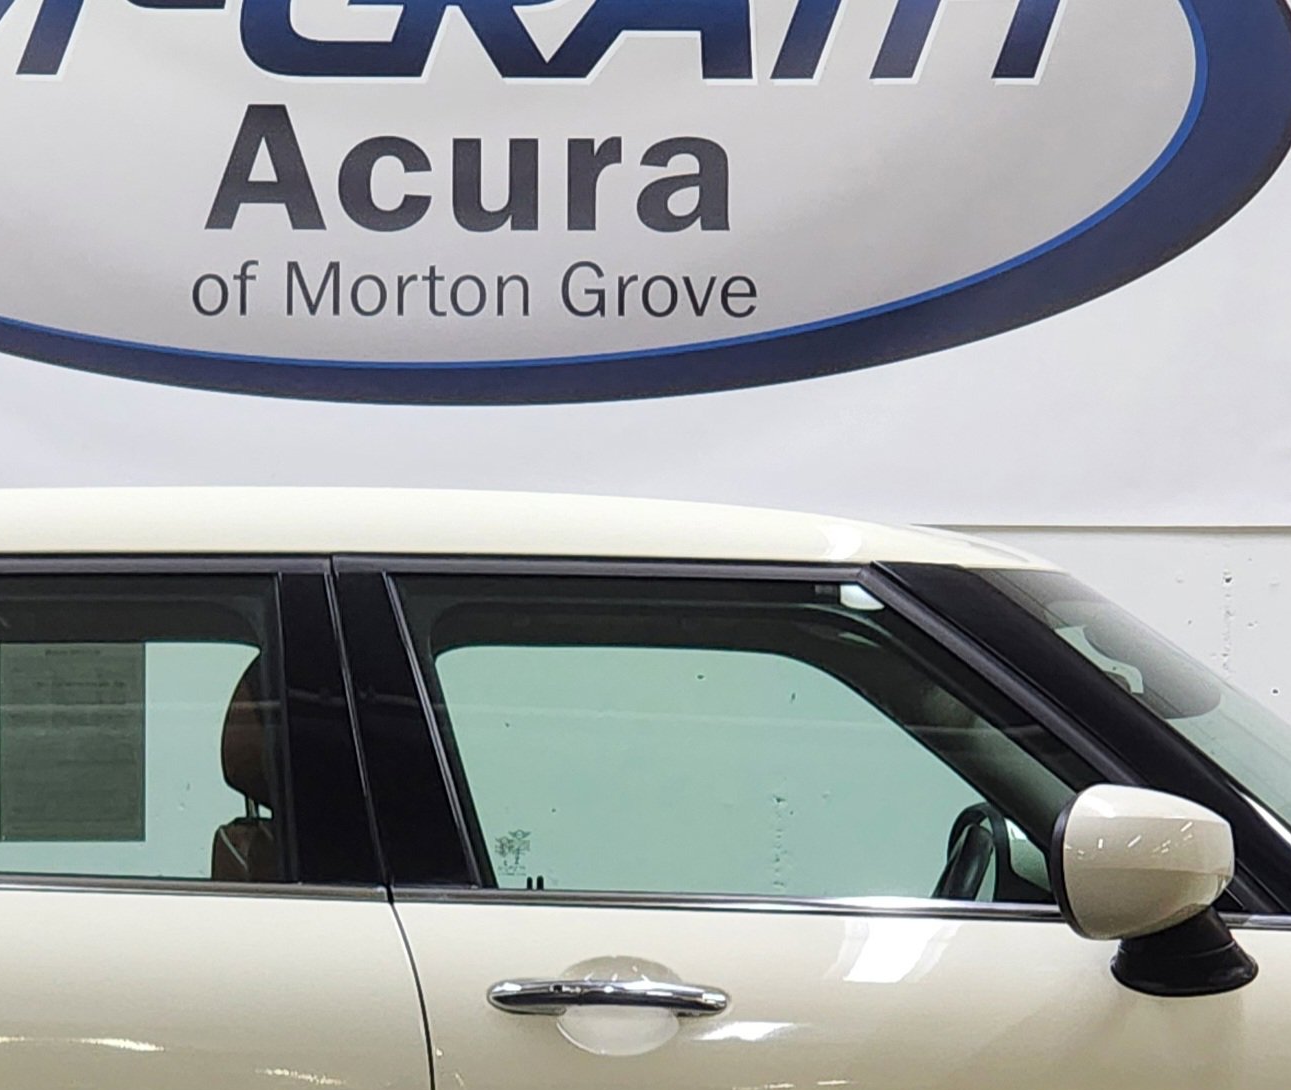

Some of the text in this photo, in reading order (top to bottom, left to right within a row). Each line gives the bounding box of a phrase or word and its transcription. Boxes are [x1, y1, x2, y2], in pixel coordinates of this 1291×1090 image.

[205, 103, 730, 233] Acura
[193, 260, 758, 318] of Morton Grove
